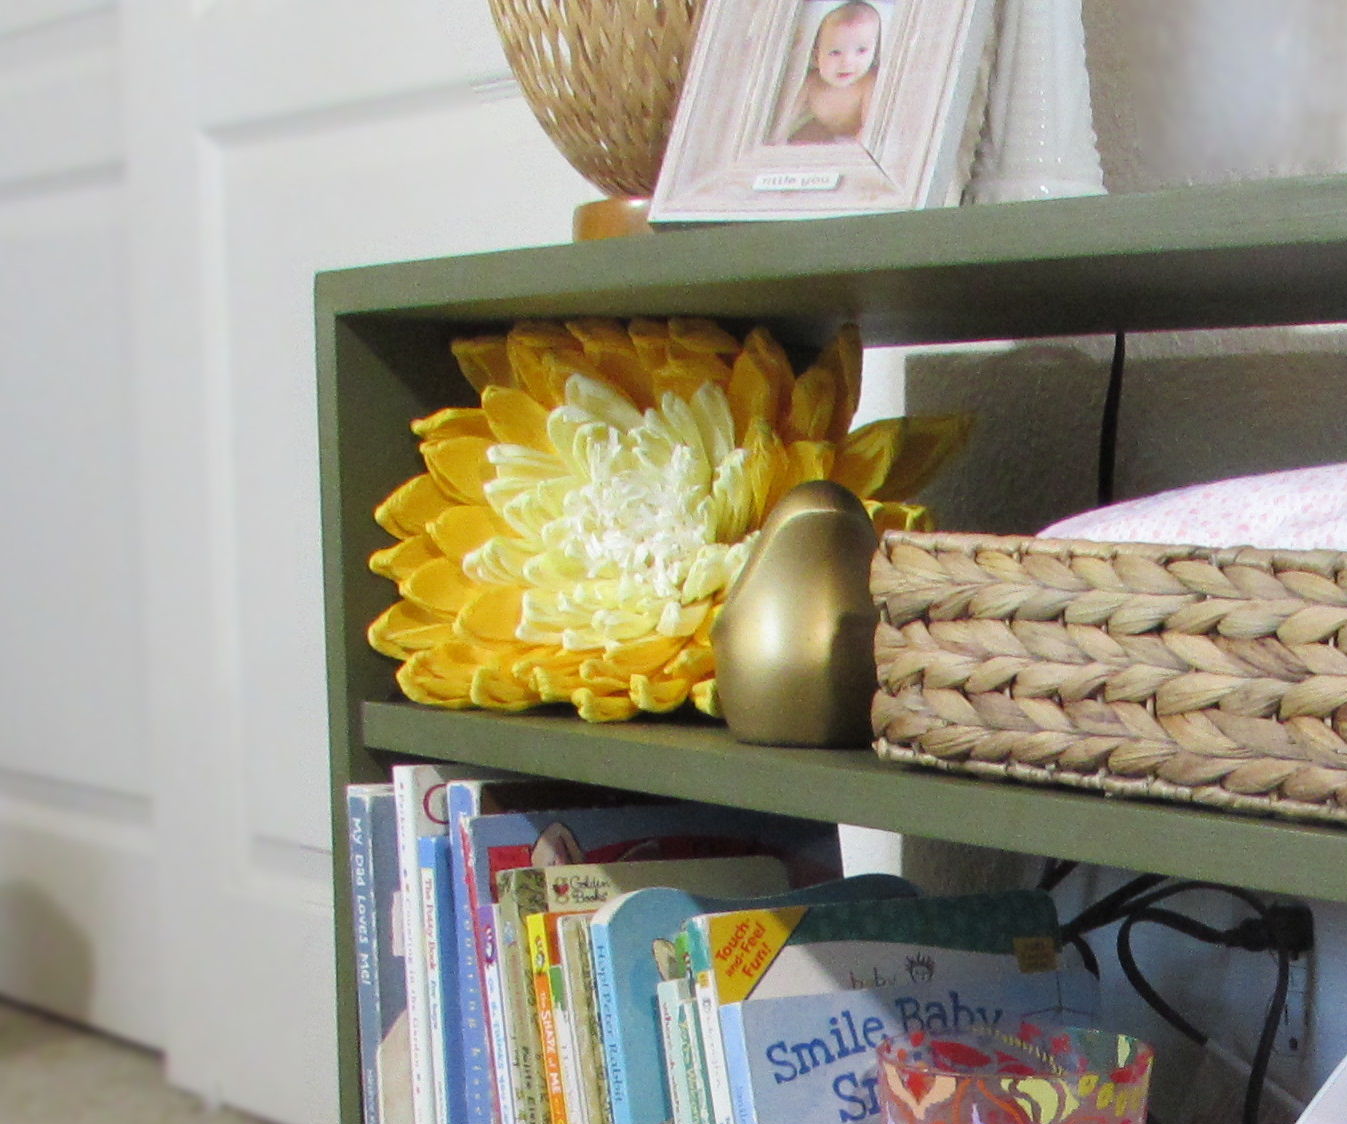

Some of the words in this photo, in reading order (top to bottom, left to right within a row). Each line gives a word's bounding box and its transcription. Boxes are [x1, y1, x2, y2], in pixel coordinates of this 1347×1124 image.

[355, 854, 366, 885] Dad
[742, 942, 772, 978] Fun!
[551, 1071, 561, 1093] ME
[608, 1043, 625, 1103] Rabbit
